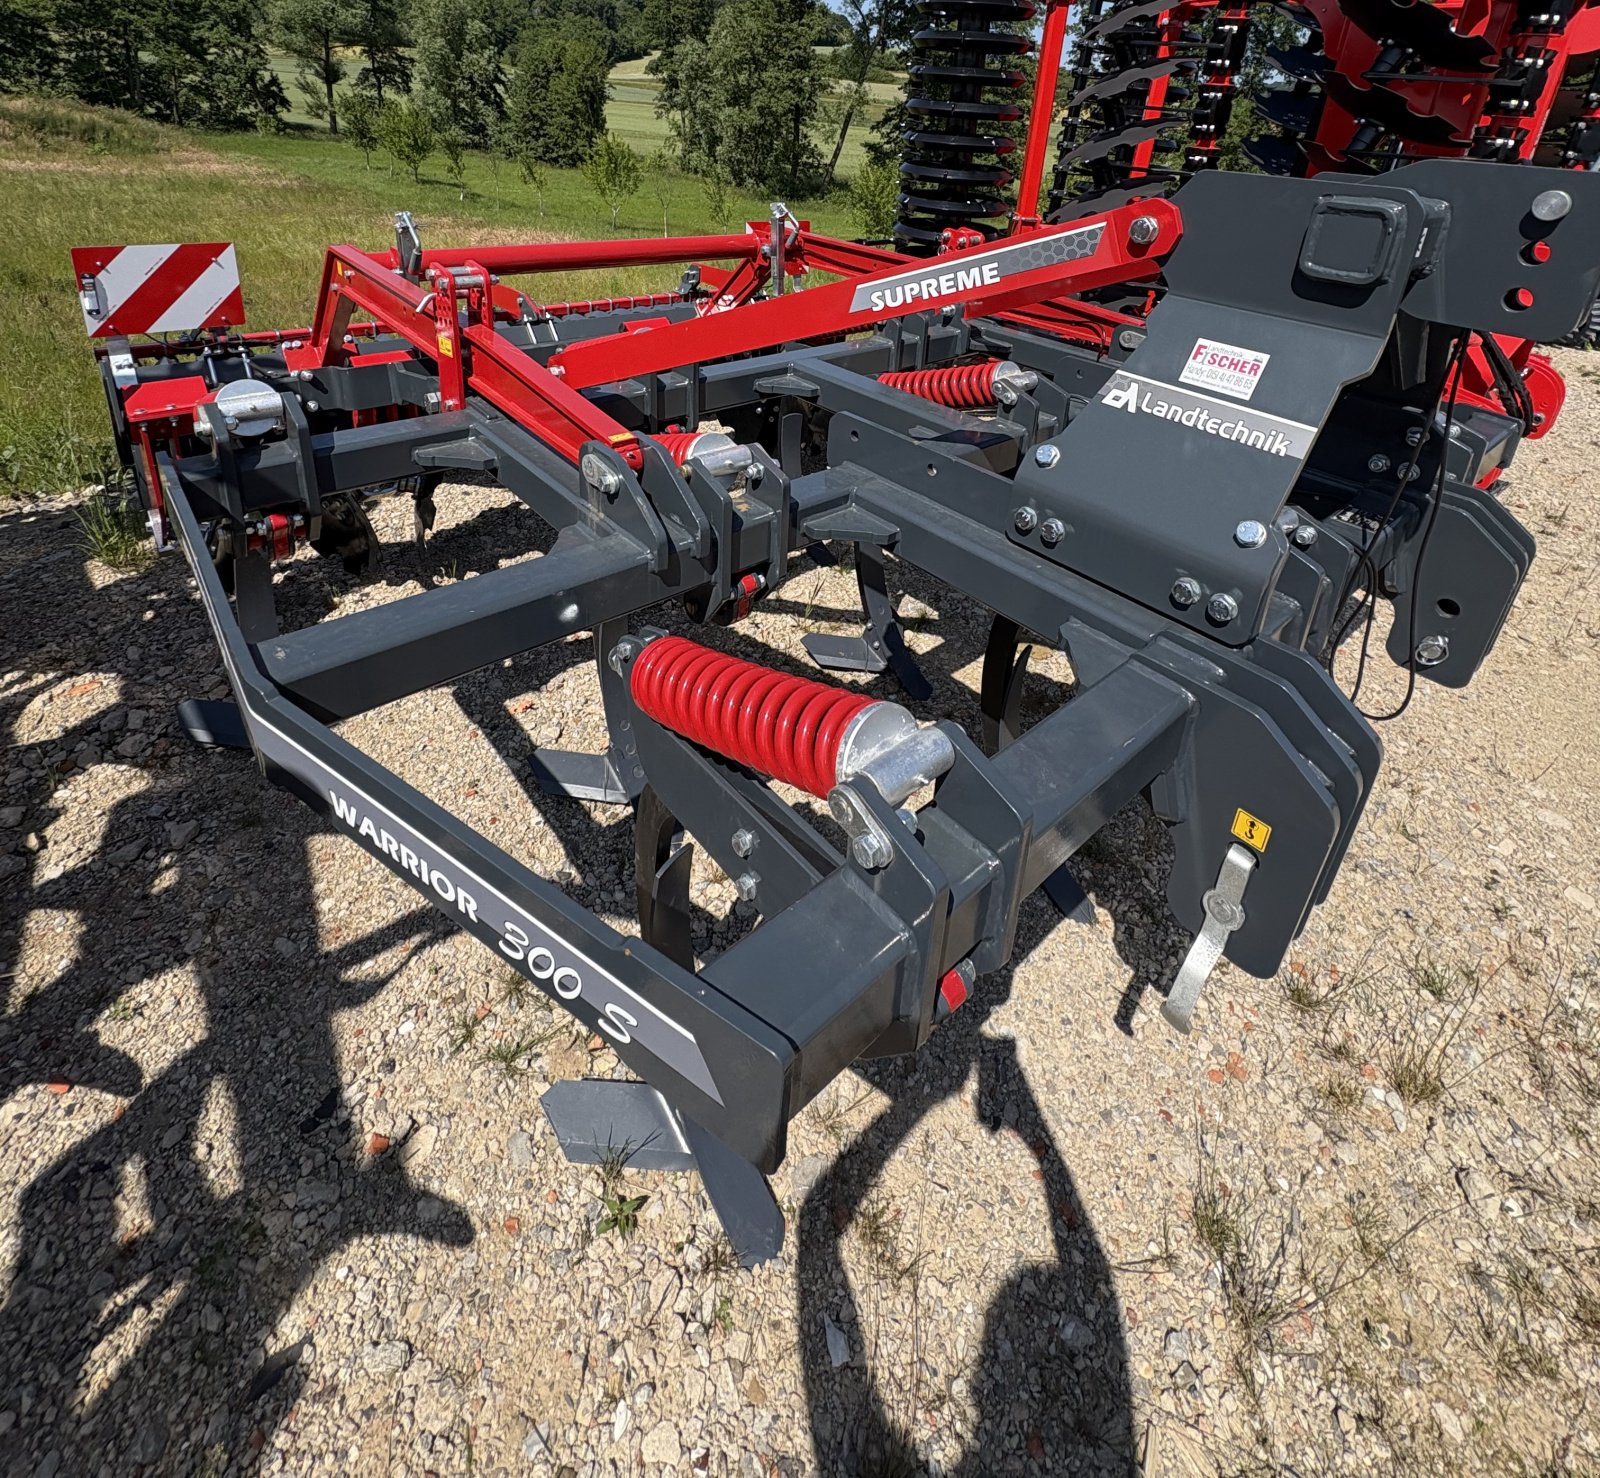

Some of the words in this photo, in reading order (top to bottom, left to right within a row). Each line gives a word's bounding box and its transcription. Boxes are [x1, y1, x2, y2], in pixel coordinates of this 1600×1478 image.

[871, 262, 1001, 312] SUPREME
[1192, 344, 1261, 377] FISCHER
[1207, 344, 1243, 358] Landtechnik
[1141, 392, 1292, 457] Landtechnik
[329, 790, 478, 923] WARRIOR
[498, 921, 583, 1000] 300
[597, 1002, 638, 1044] S
